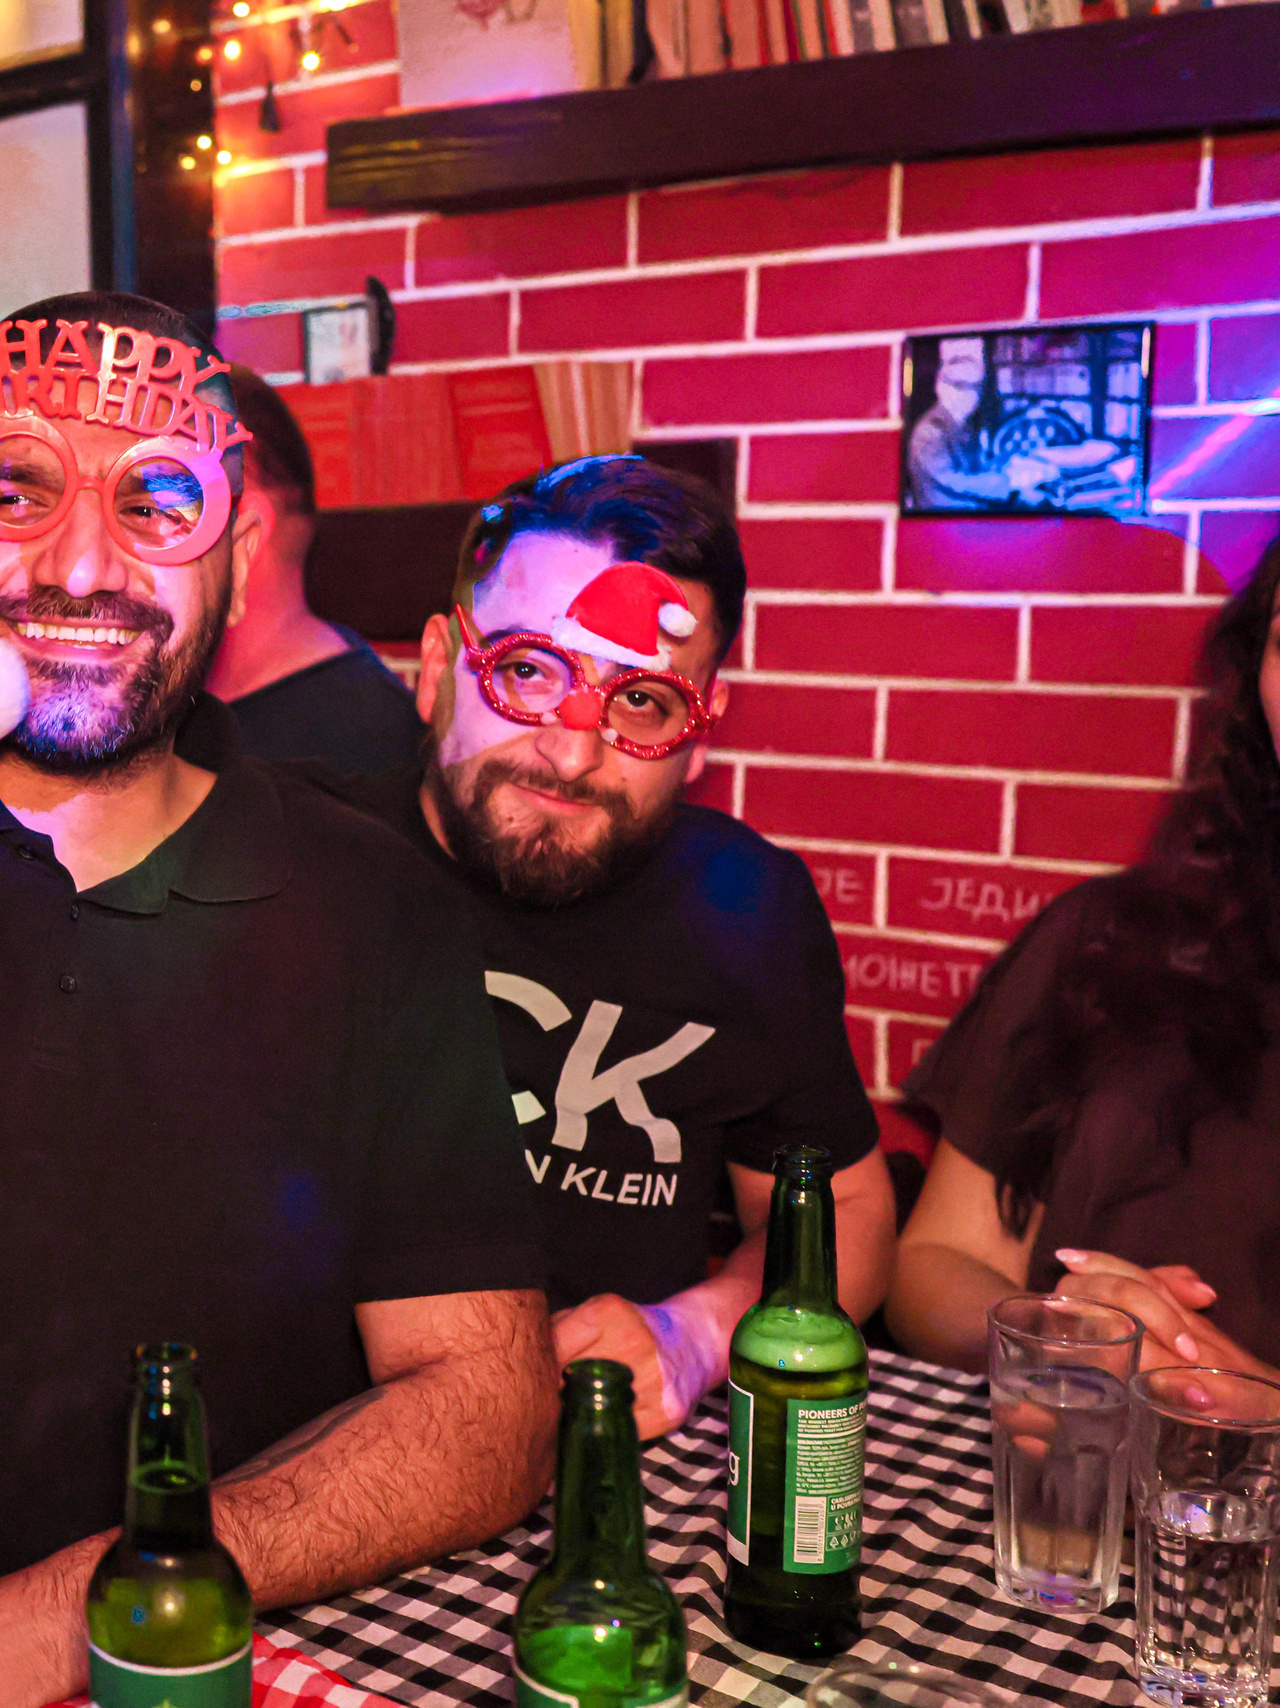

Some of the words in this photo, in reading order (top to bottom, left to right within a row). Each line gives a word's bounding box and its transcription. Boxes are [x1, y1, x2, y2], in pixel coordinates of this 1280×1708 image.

[918, 877, 1053, 924] ЈЕДИ
[560, 1162, 678, 1206] KLEIN
[798, 1407, 848, 1420] PIONEERS
[848, 1404, 859, 1415] OF
